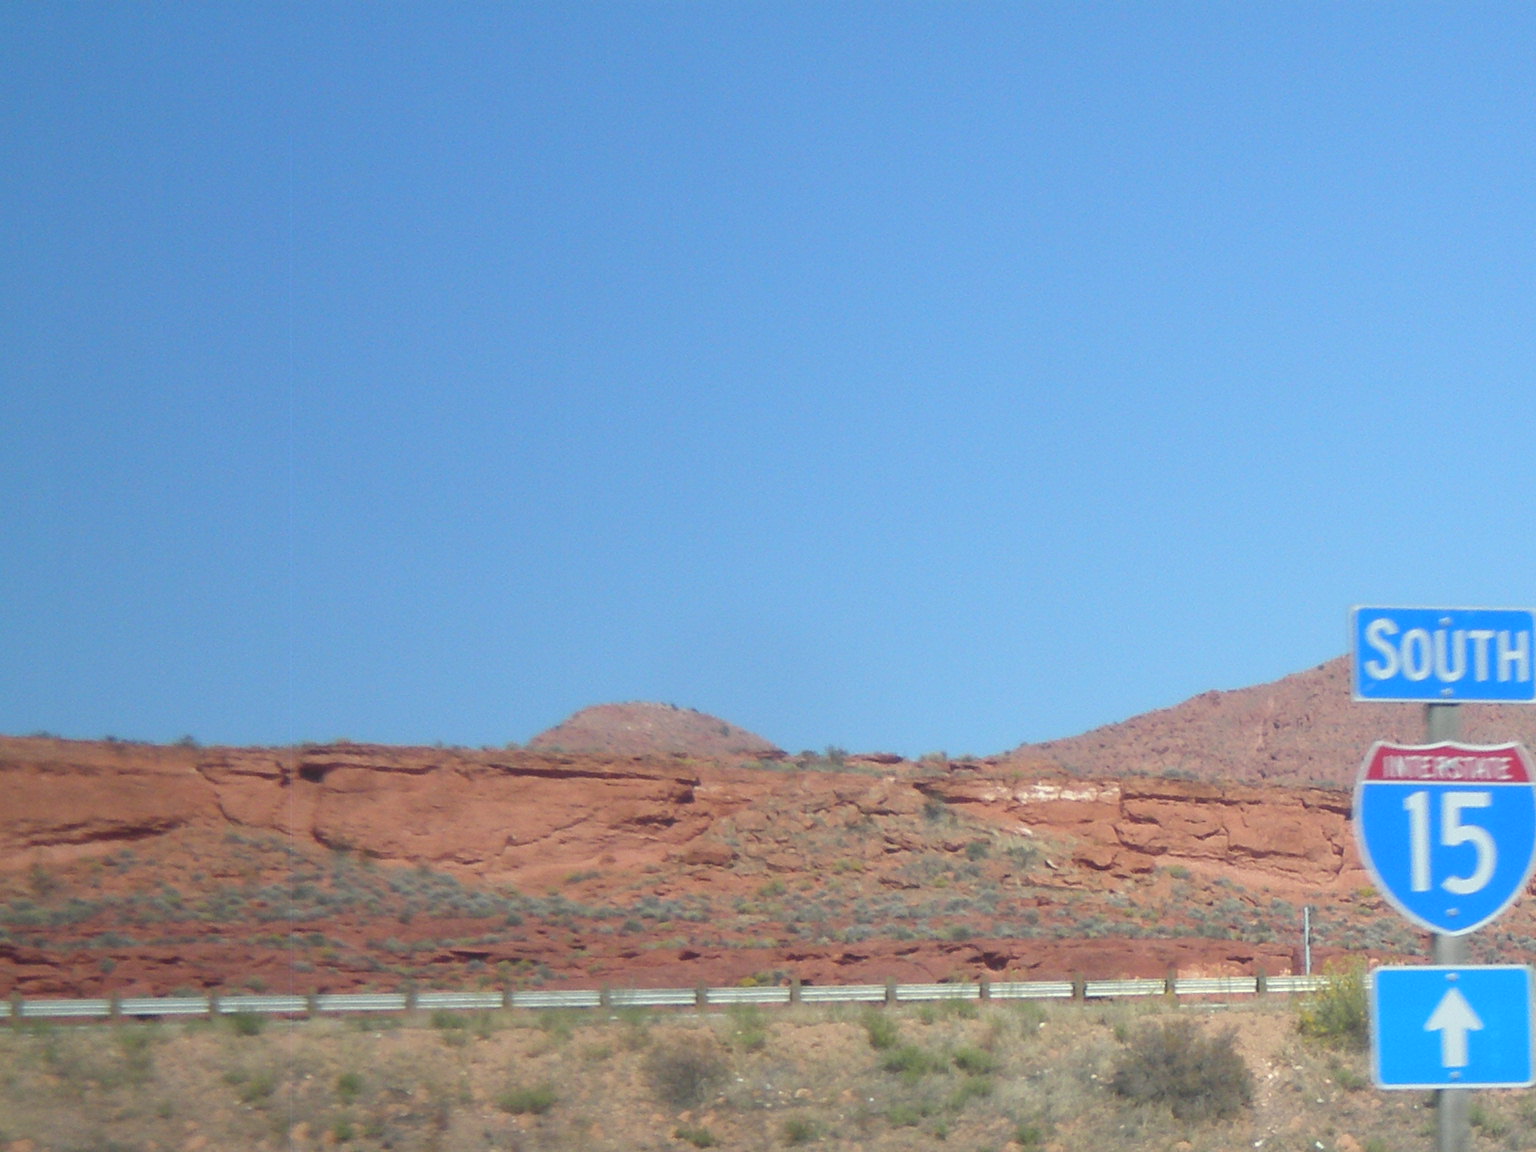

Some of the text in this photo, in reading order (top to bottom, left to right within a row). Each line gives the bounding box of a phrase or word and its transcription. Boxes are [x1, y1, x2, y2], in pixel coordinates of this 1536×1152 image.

[1365, 617, 1530, 682] SOUTH
[1382, 754, 1514, 780] INTERSTATE
[1403, 790, 1497, 895] 15
